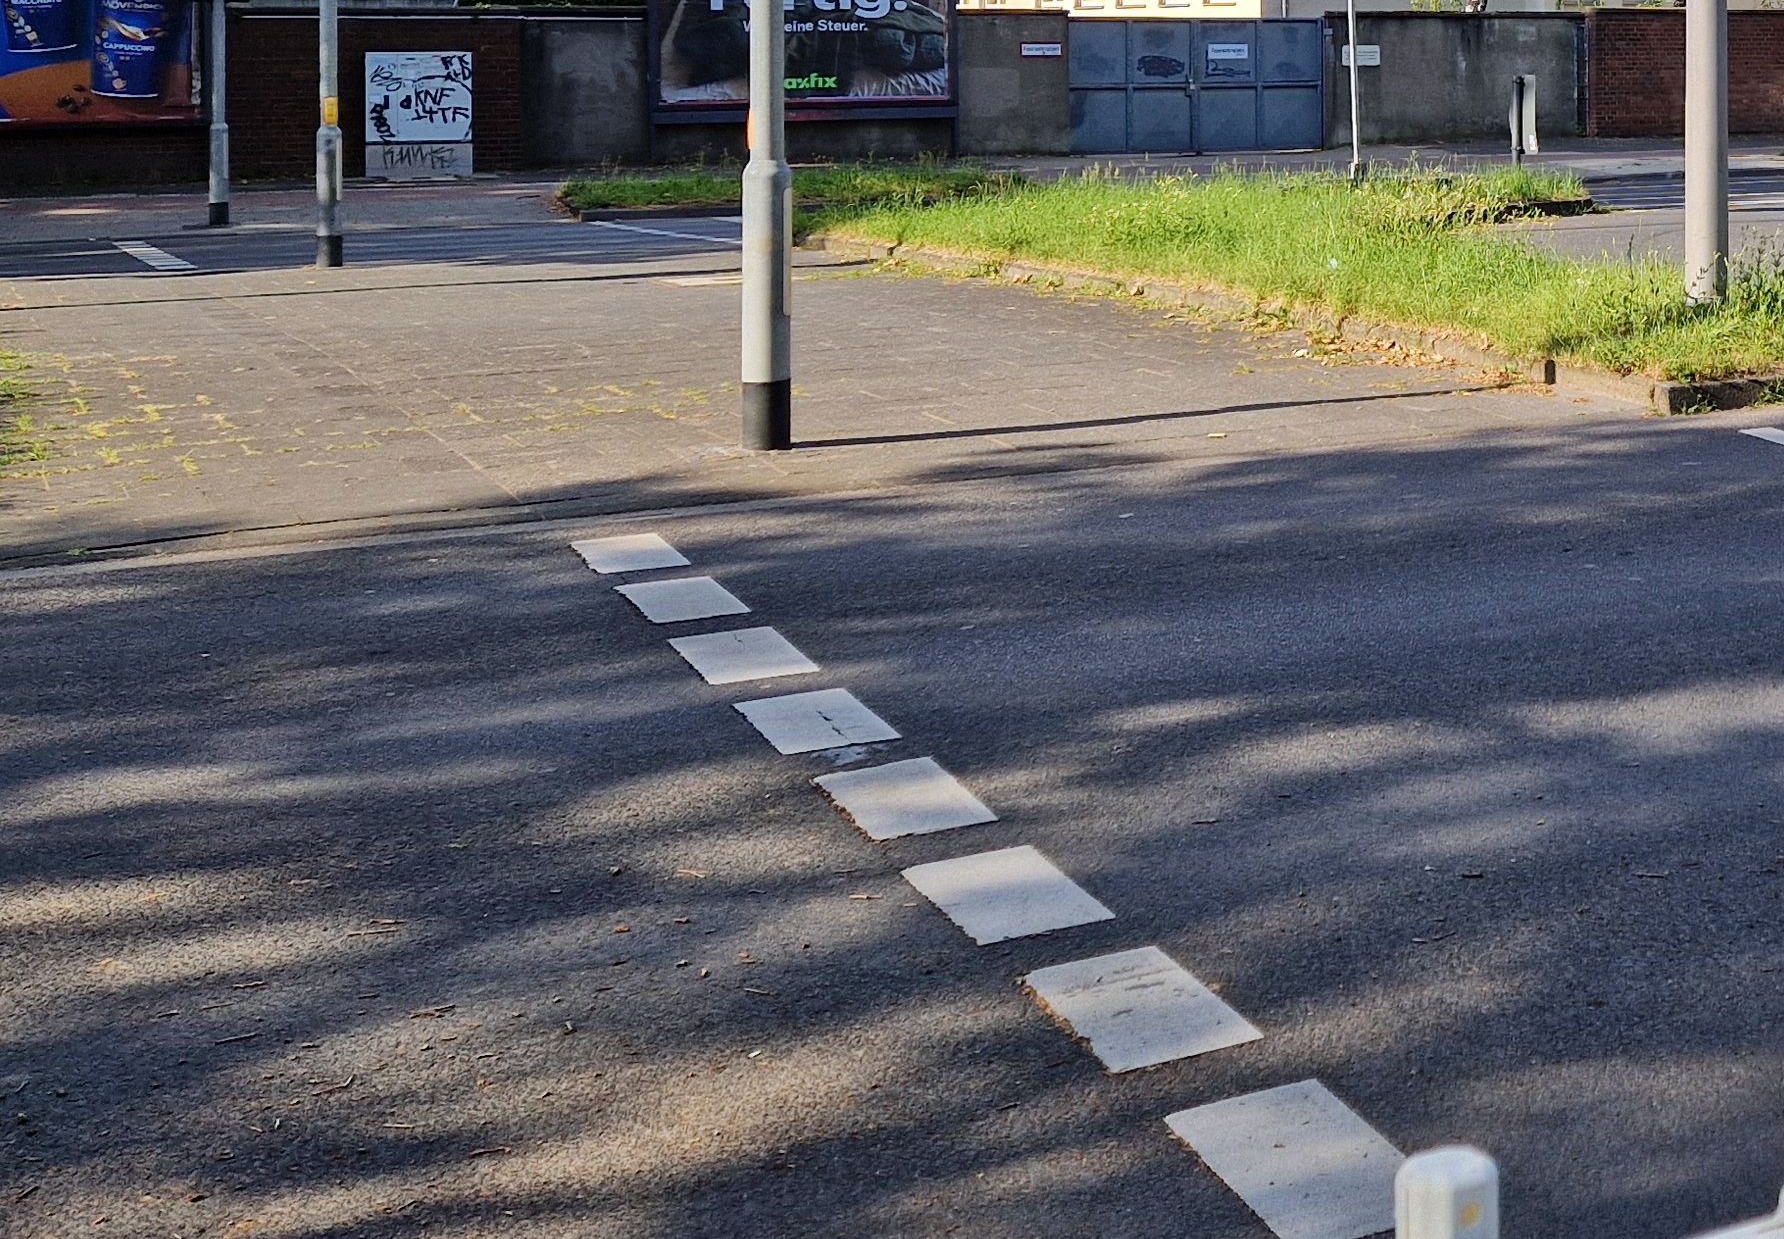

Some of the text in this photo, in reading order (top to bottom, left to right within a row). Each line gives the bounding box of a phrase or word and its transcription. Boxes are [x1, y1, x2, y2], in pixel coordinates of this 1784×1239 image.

[817, 19, 868, 32] Steuer.
[102, 41, 155, 52] CAPPUCCINO
[784, 73, 838, 89] axfix
